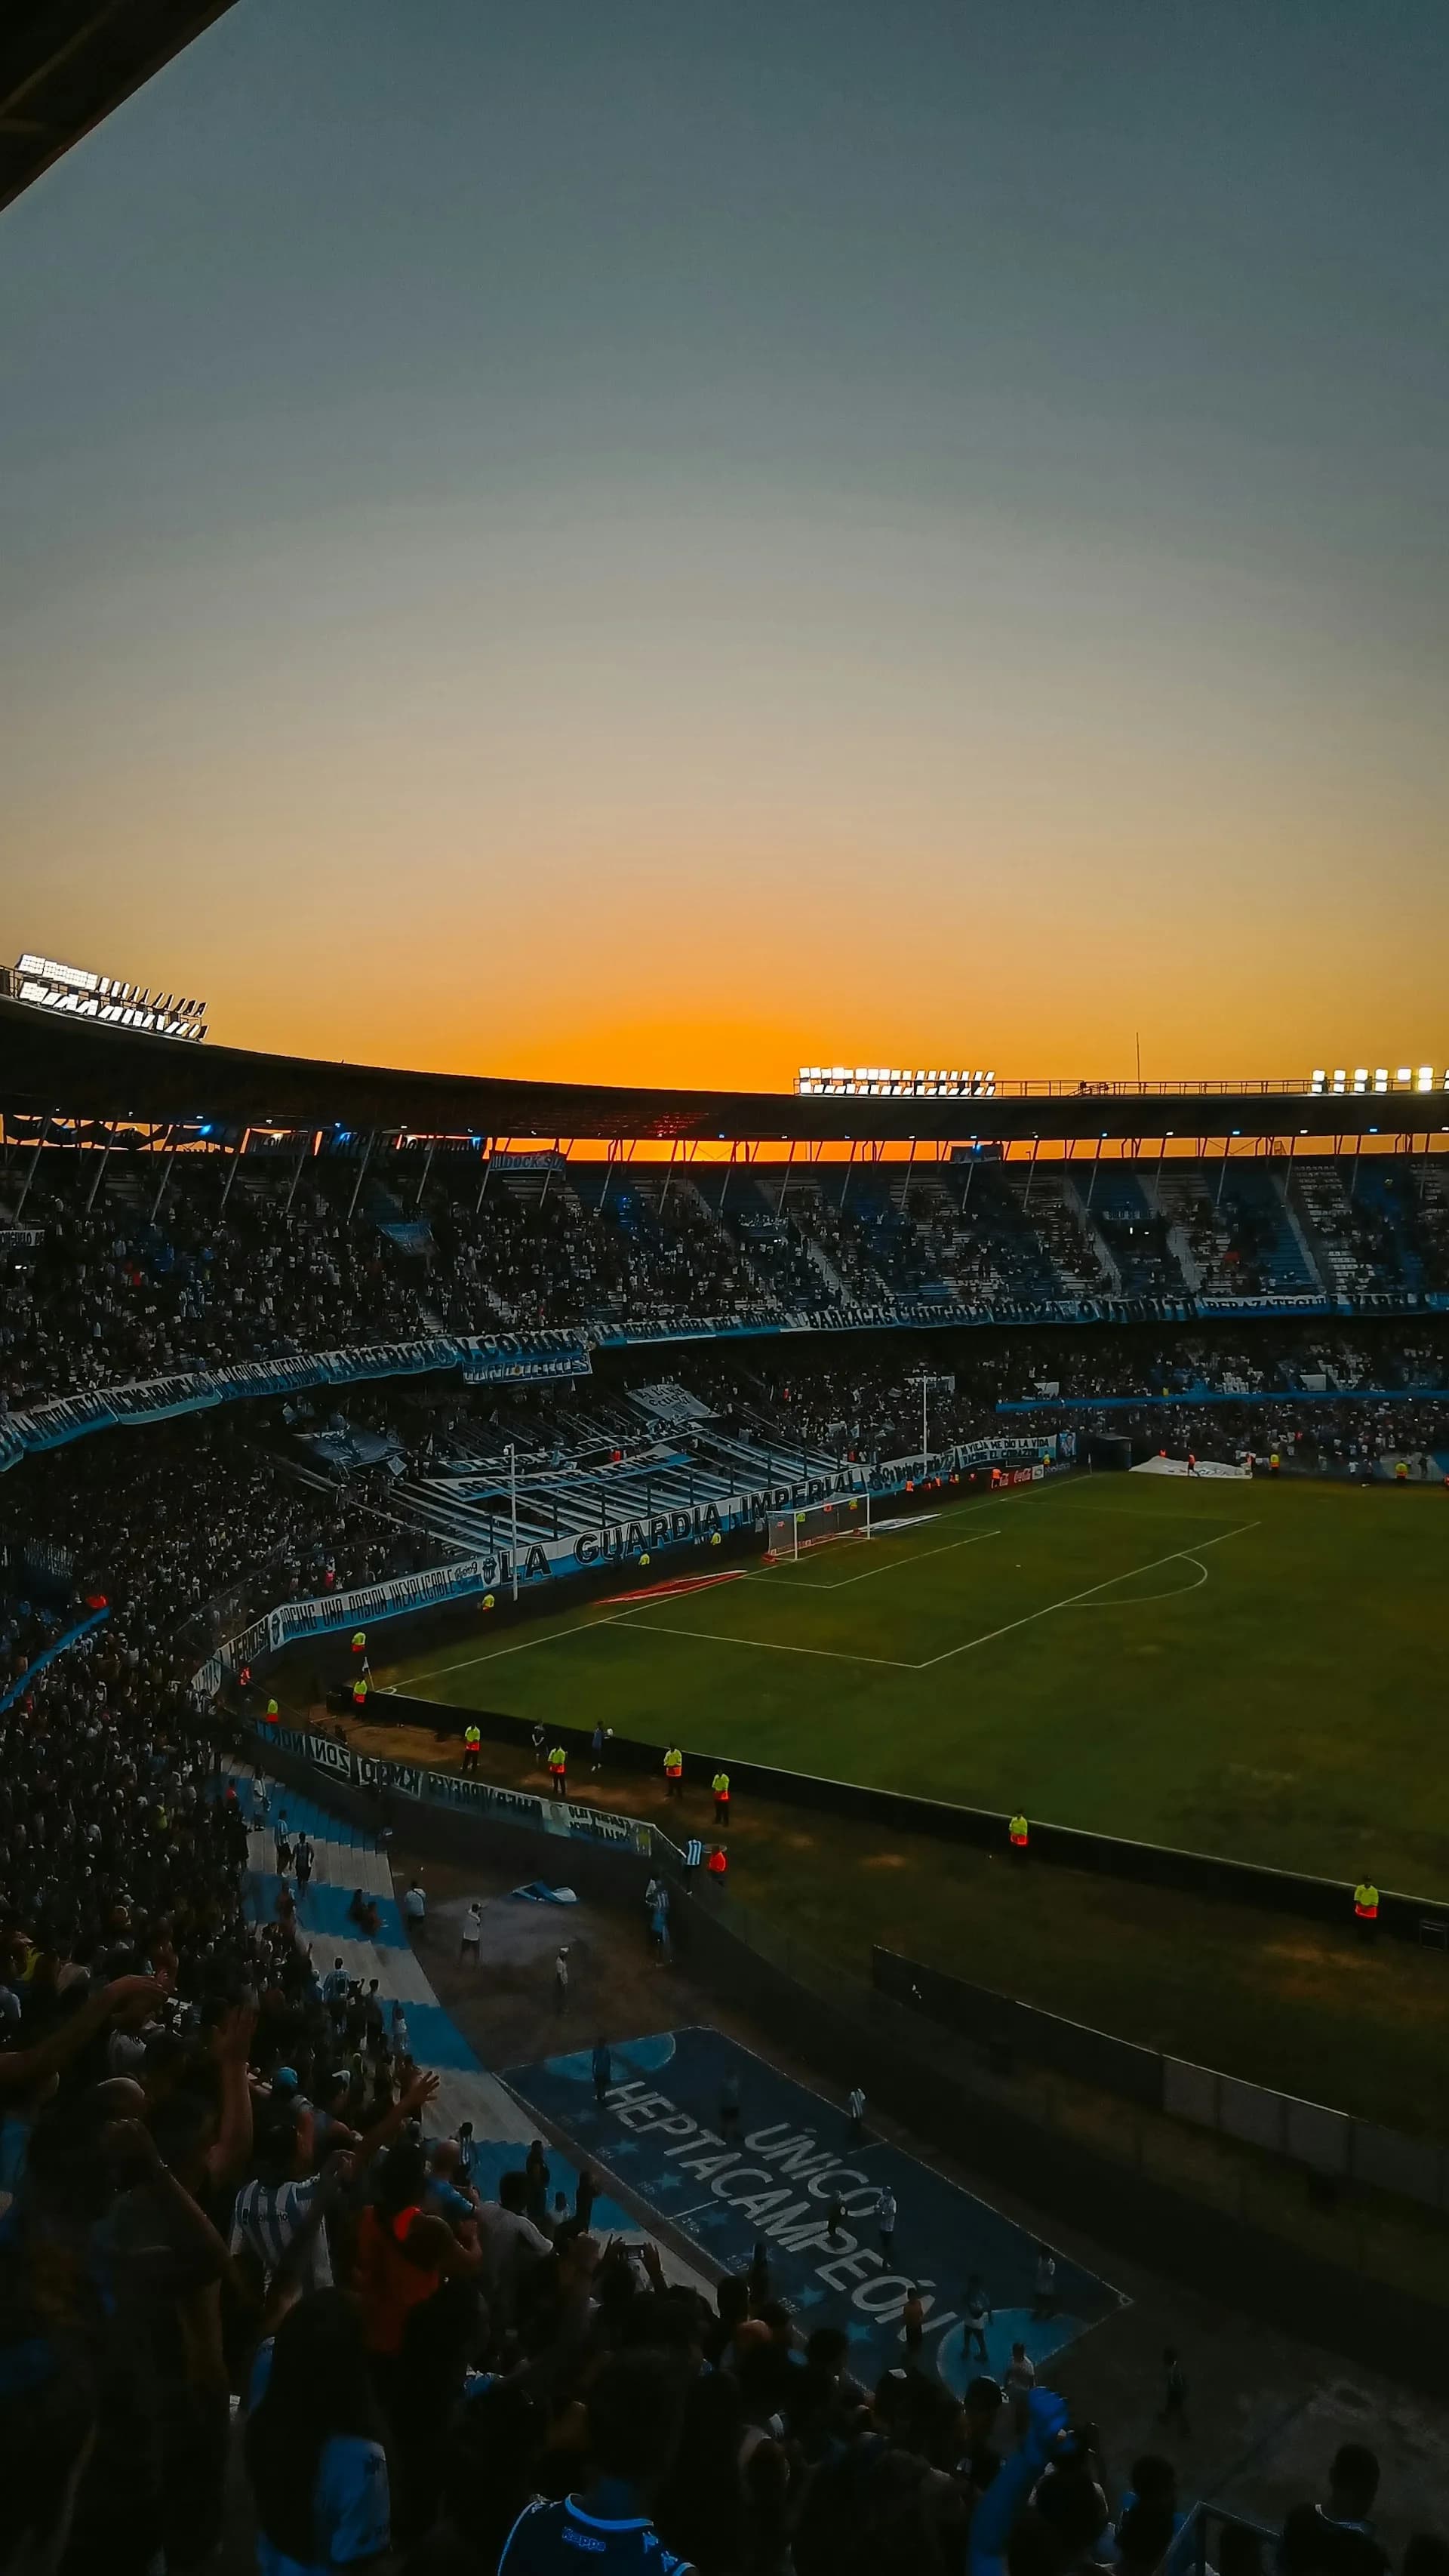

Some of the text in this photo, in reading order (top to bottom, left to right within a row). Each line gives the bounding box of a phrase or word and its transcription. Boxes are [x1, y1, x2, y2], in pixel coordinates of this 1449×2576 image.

[808, 1306, 895, 1328] BARRACAS
[1208, 1297, 1327, 1311] BERAZATEGUI
[967, 1441, 988, 1452] VIEJA
[990, 1440, 1001, 1449] ME
[1018, 1439, 1028, 1448] LA
[1032, 1437, 1048, 1448] VIDA
[989, 1449, 998, 1459] EL
[497, 1546, 551, 1583] LA
[574, 1502, 720, 1565] GUARDIA
[742, 1468, 866, 1523] IMPERIAL
[321, 1597, 343, 1627] UNA
[349, 1587, 388, 1621] PASION
[389, 1569, 454, 1611] INEXPLICABLE
[744, 2122, 884, 2217] ÚNICO
[605, 2081, 958, 2342] HEPTACAMPEÓN
[561, 2525, 607, 2552] Kappa
